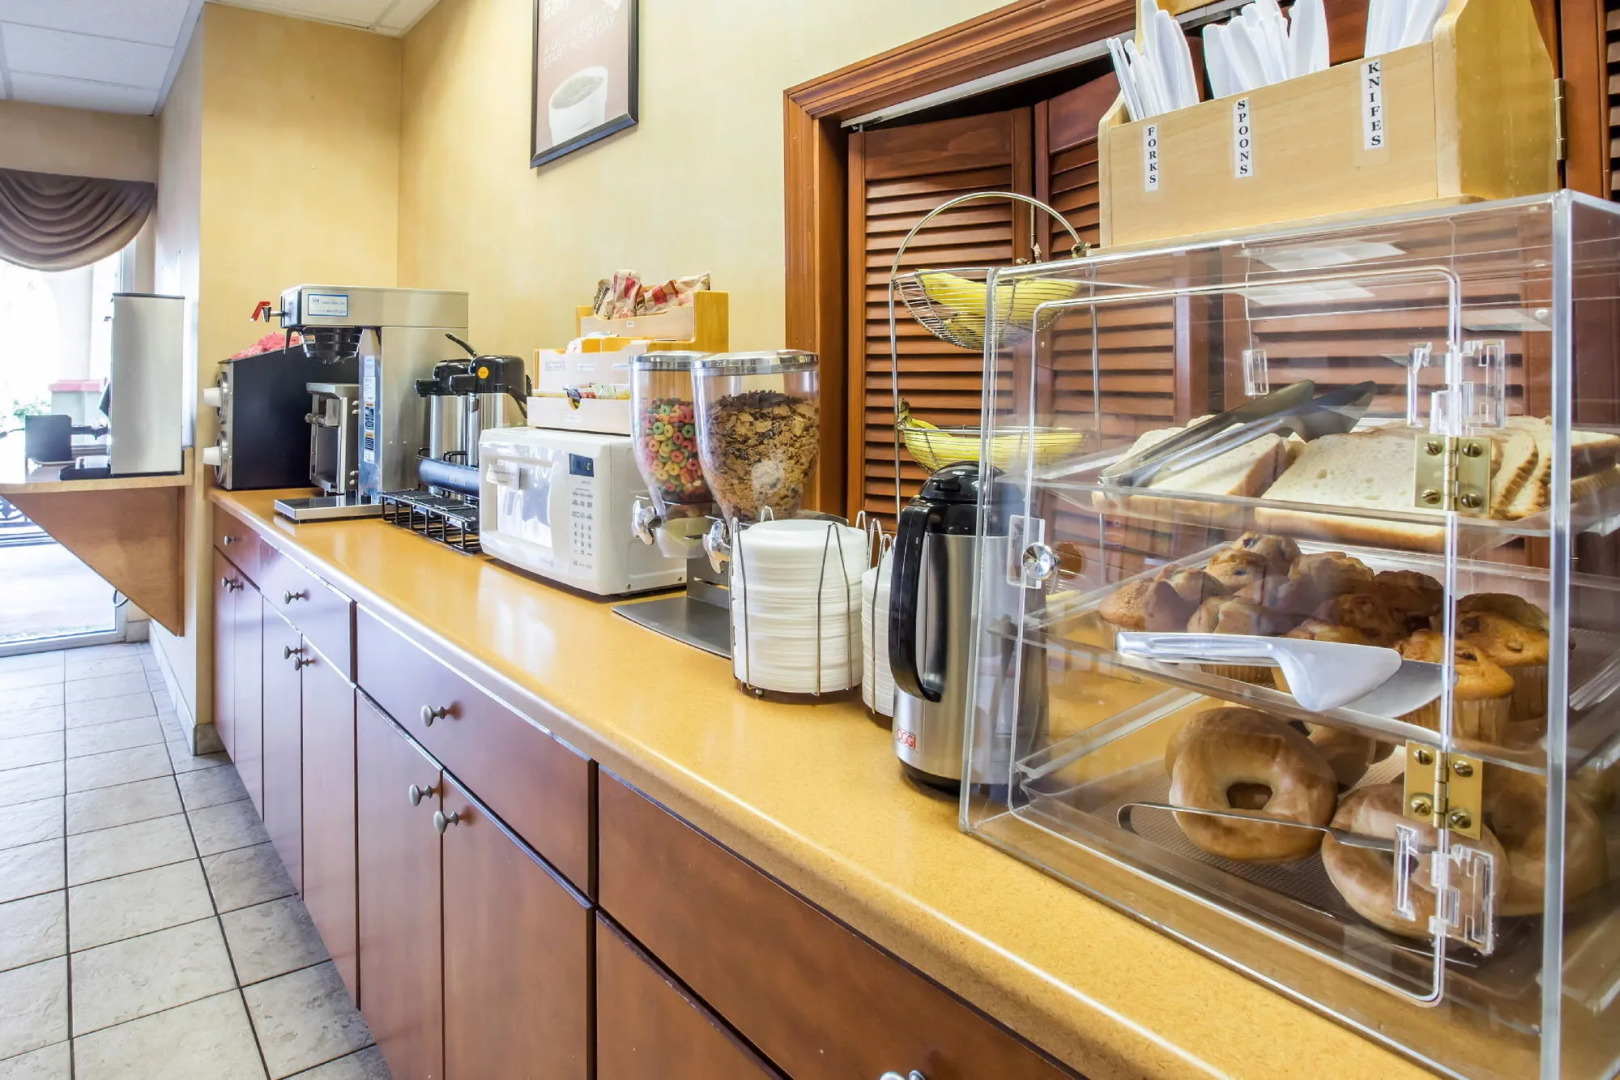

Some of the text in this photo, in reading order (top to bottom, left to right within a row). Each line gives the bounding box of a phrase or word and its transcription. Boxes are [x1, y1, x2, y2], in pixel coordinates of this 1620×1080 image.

[1237, 100, 1249, 175] SPOONS
[1368, 62, 1382, 147] KNIFES
[1148, 127, 1158, 184] FORKS
[897, 728, 917, 749] OGGI
